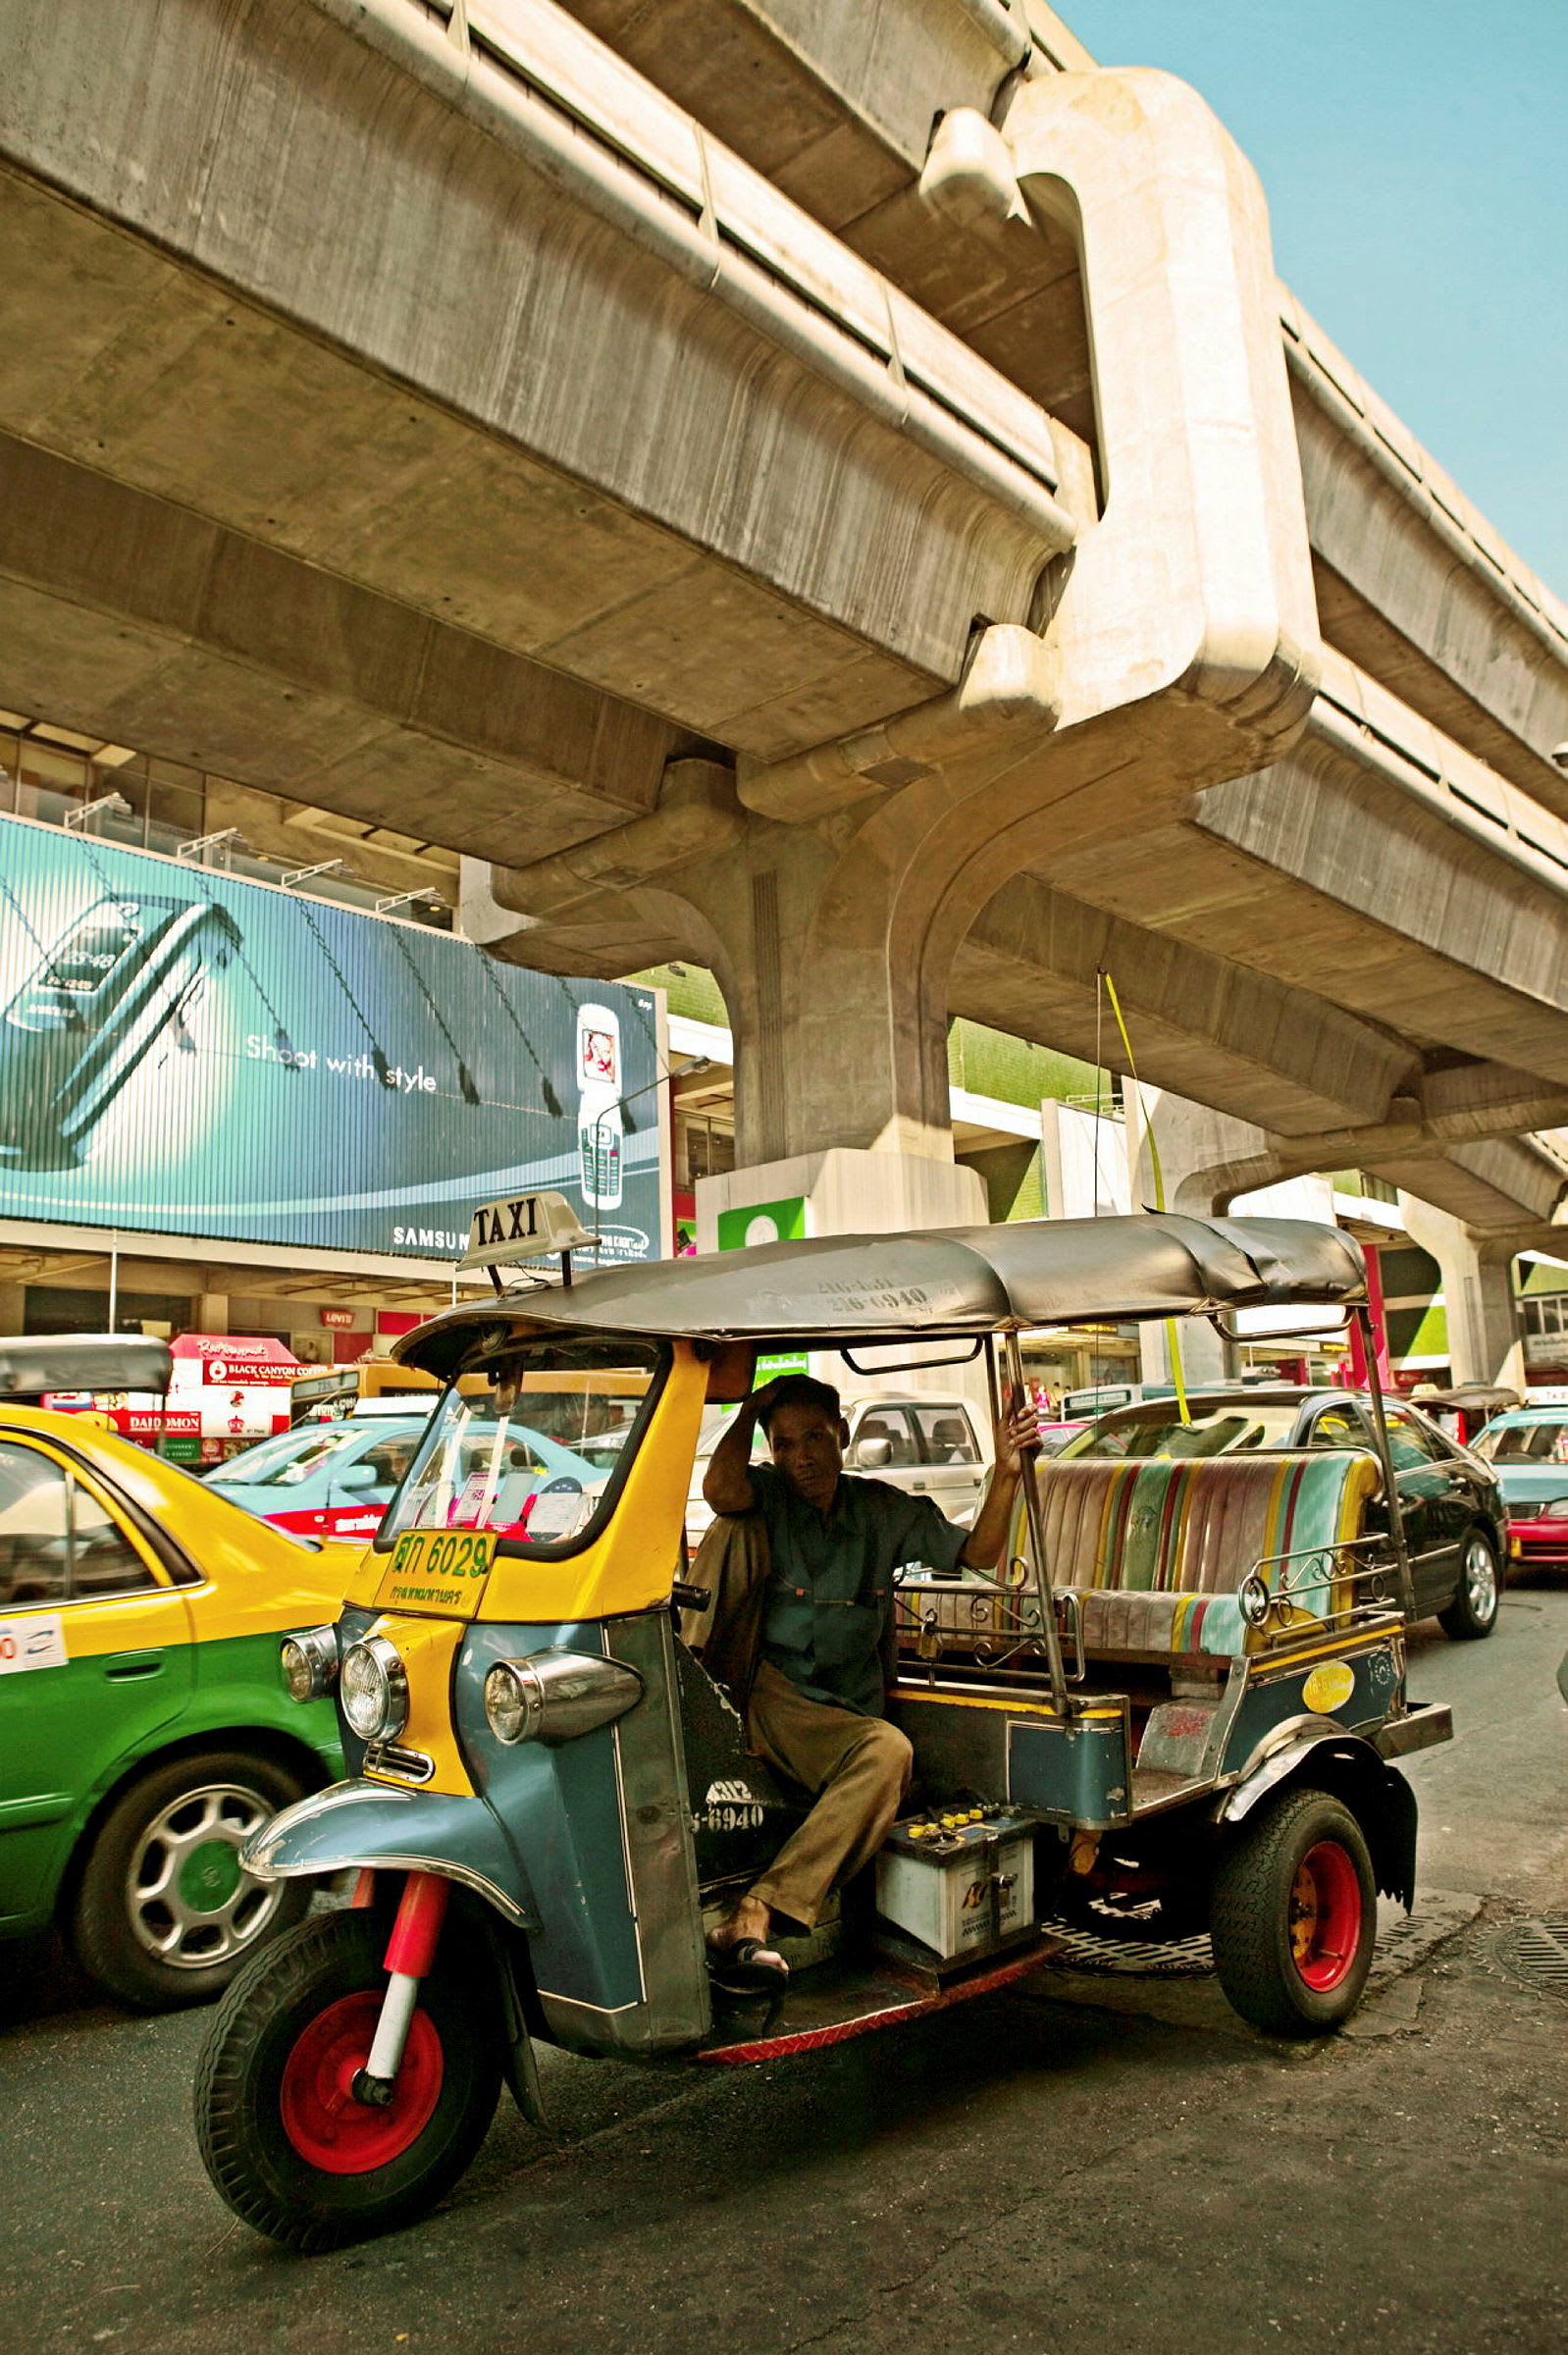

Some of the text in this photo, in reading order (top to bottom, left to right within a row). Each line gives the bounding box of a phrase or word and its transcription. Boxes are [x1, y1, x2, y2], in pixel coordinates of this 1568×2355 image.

[246, 1033, 437, 1093] Shoot with style
[473, 1197, 538, 1246] TAXI
[228, 1364, 257, 1374] BLACK
[258, 1365, 295, 1375] CANYON
[427, 1536, 488, 1578] 6029
